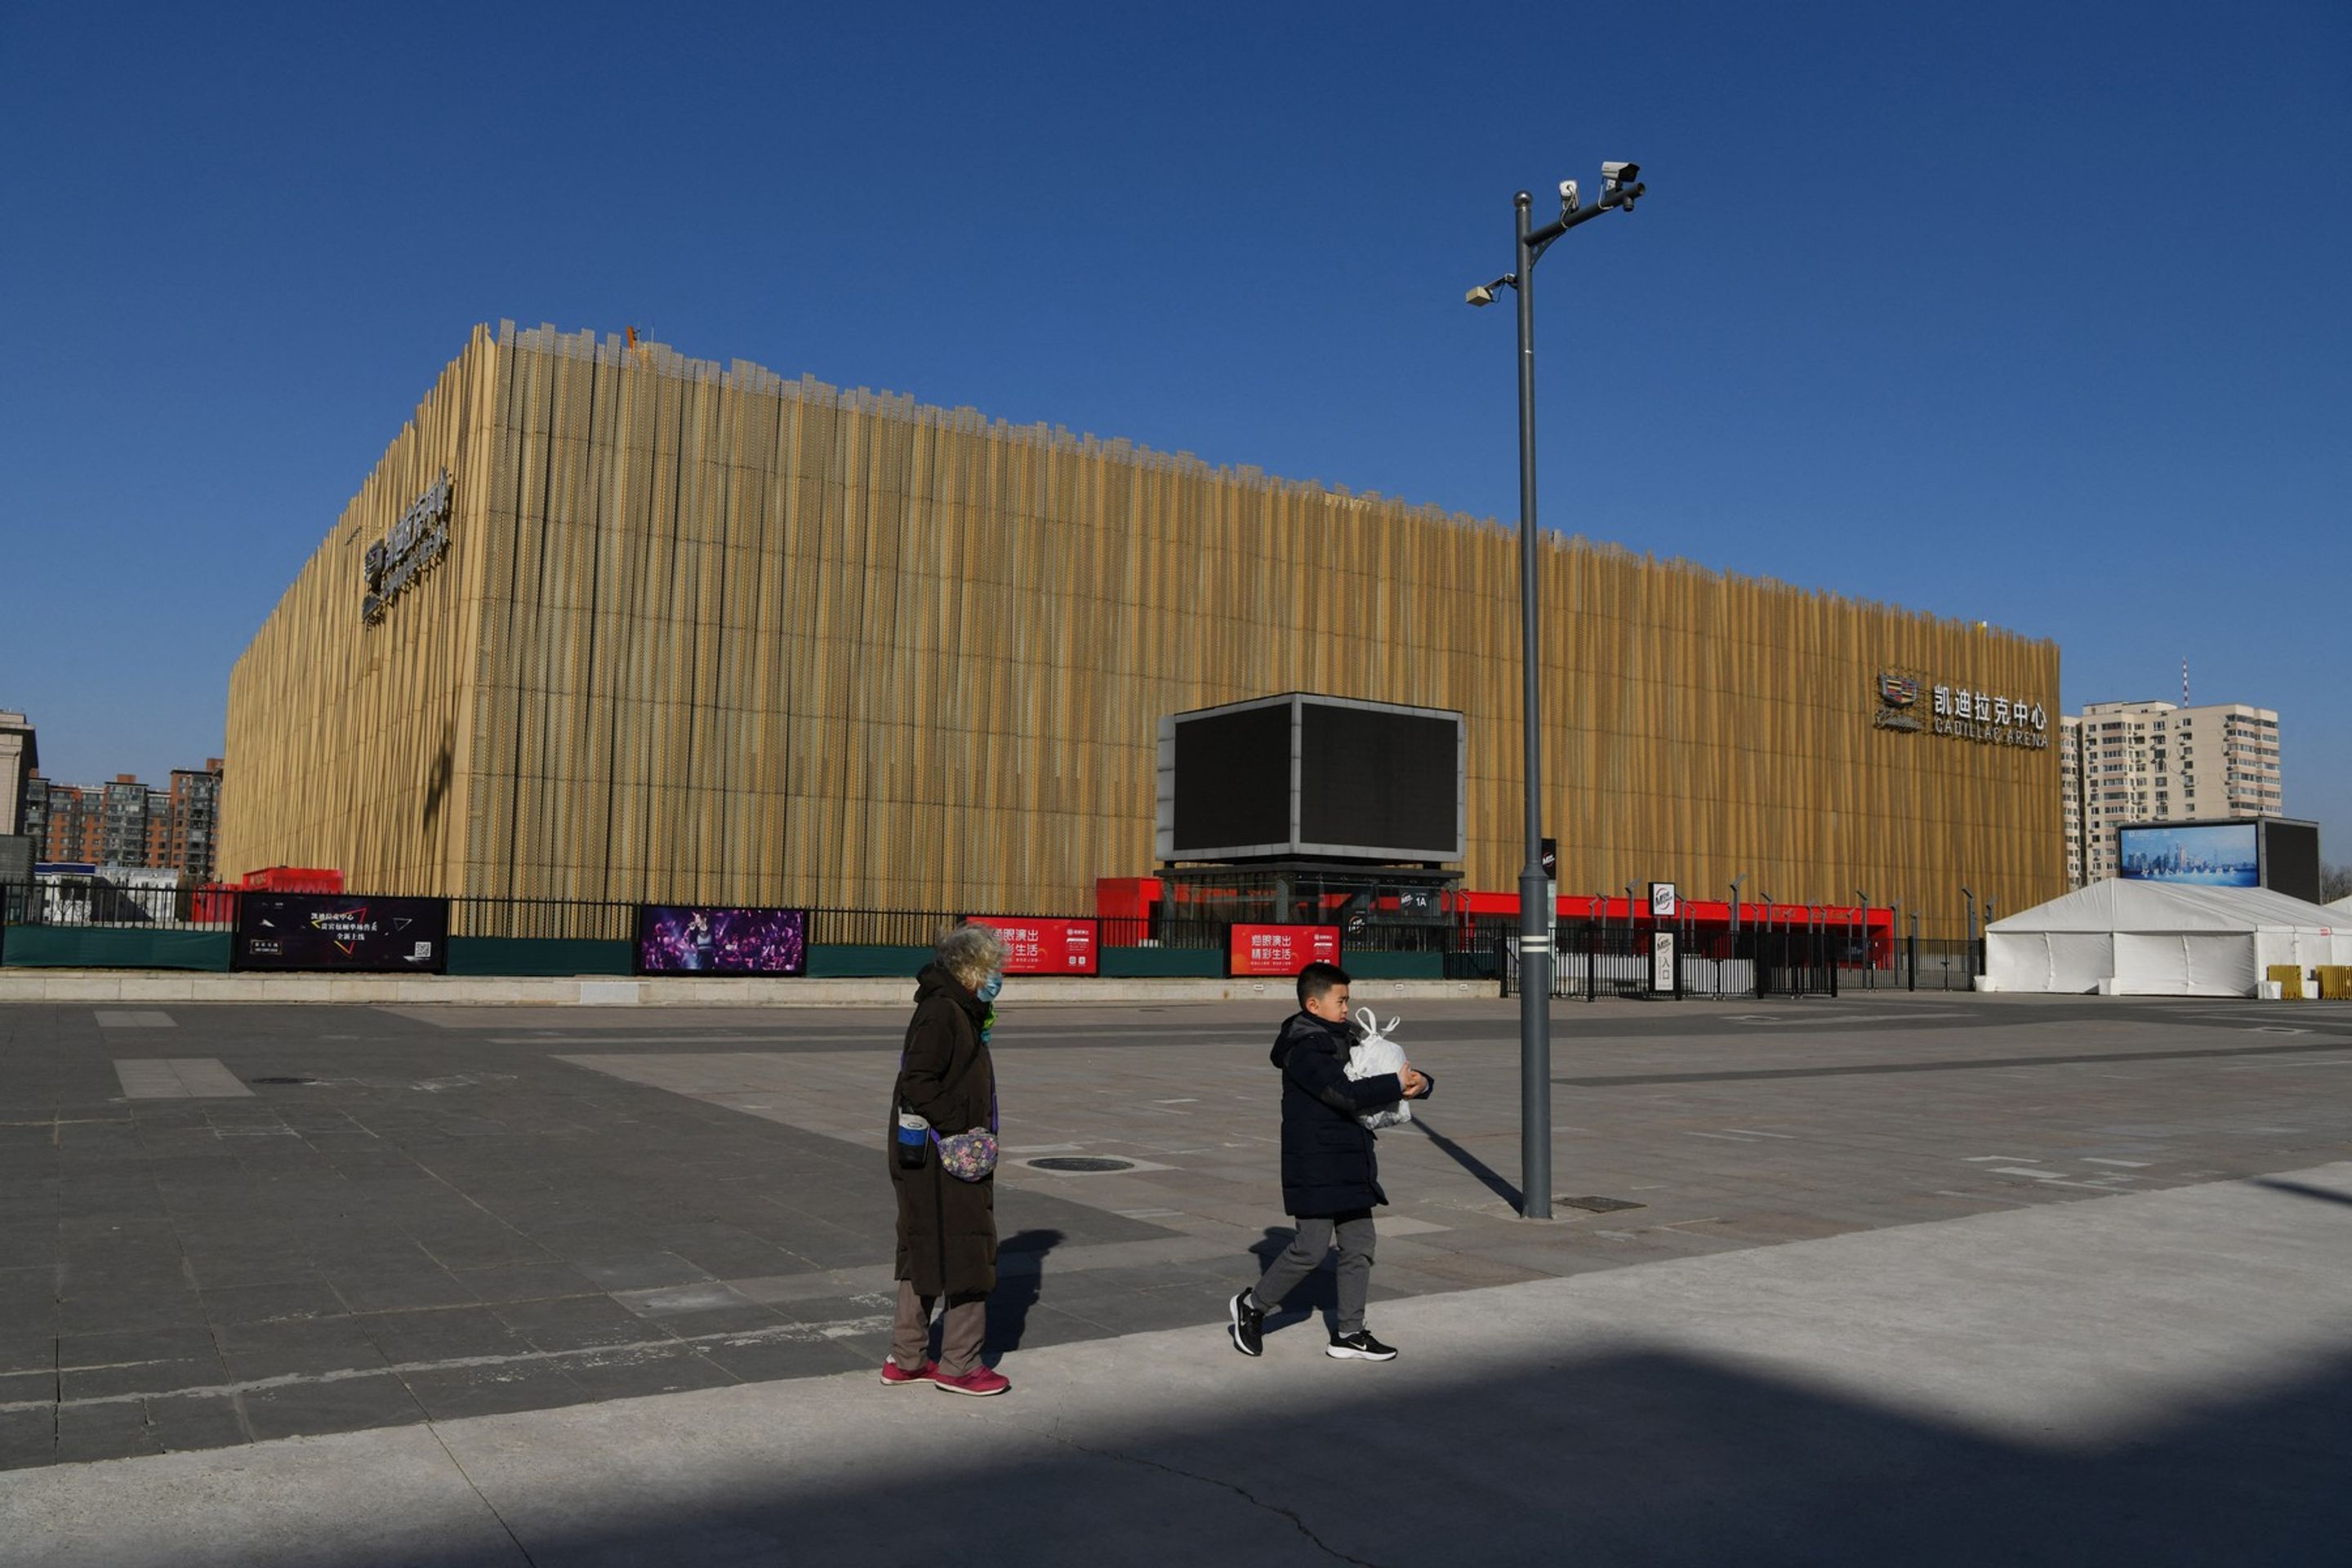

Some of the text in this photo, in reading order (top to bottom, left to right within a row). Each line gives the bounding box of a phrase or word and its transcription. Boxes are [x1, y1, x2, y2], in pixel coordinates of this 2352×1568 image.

[1934, 684, 2047, 730] 凯迪拉克中心
[1935, 716, 2002, 741] CADILLAC
[2006, 728, 2049, 748] ARENA
[1416, 897, 1427, 906] 1A
[1252, 934, 1291, 947] 猫眼演出
[1252, 948, 1291, 960] 精彩生活
[1661, 956, 1670, 980] 入口
